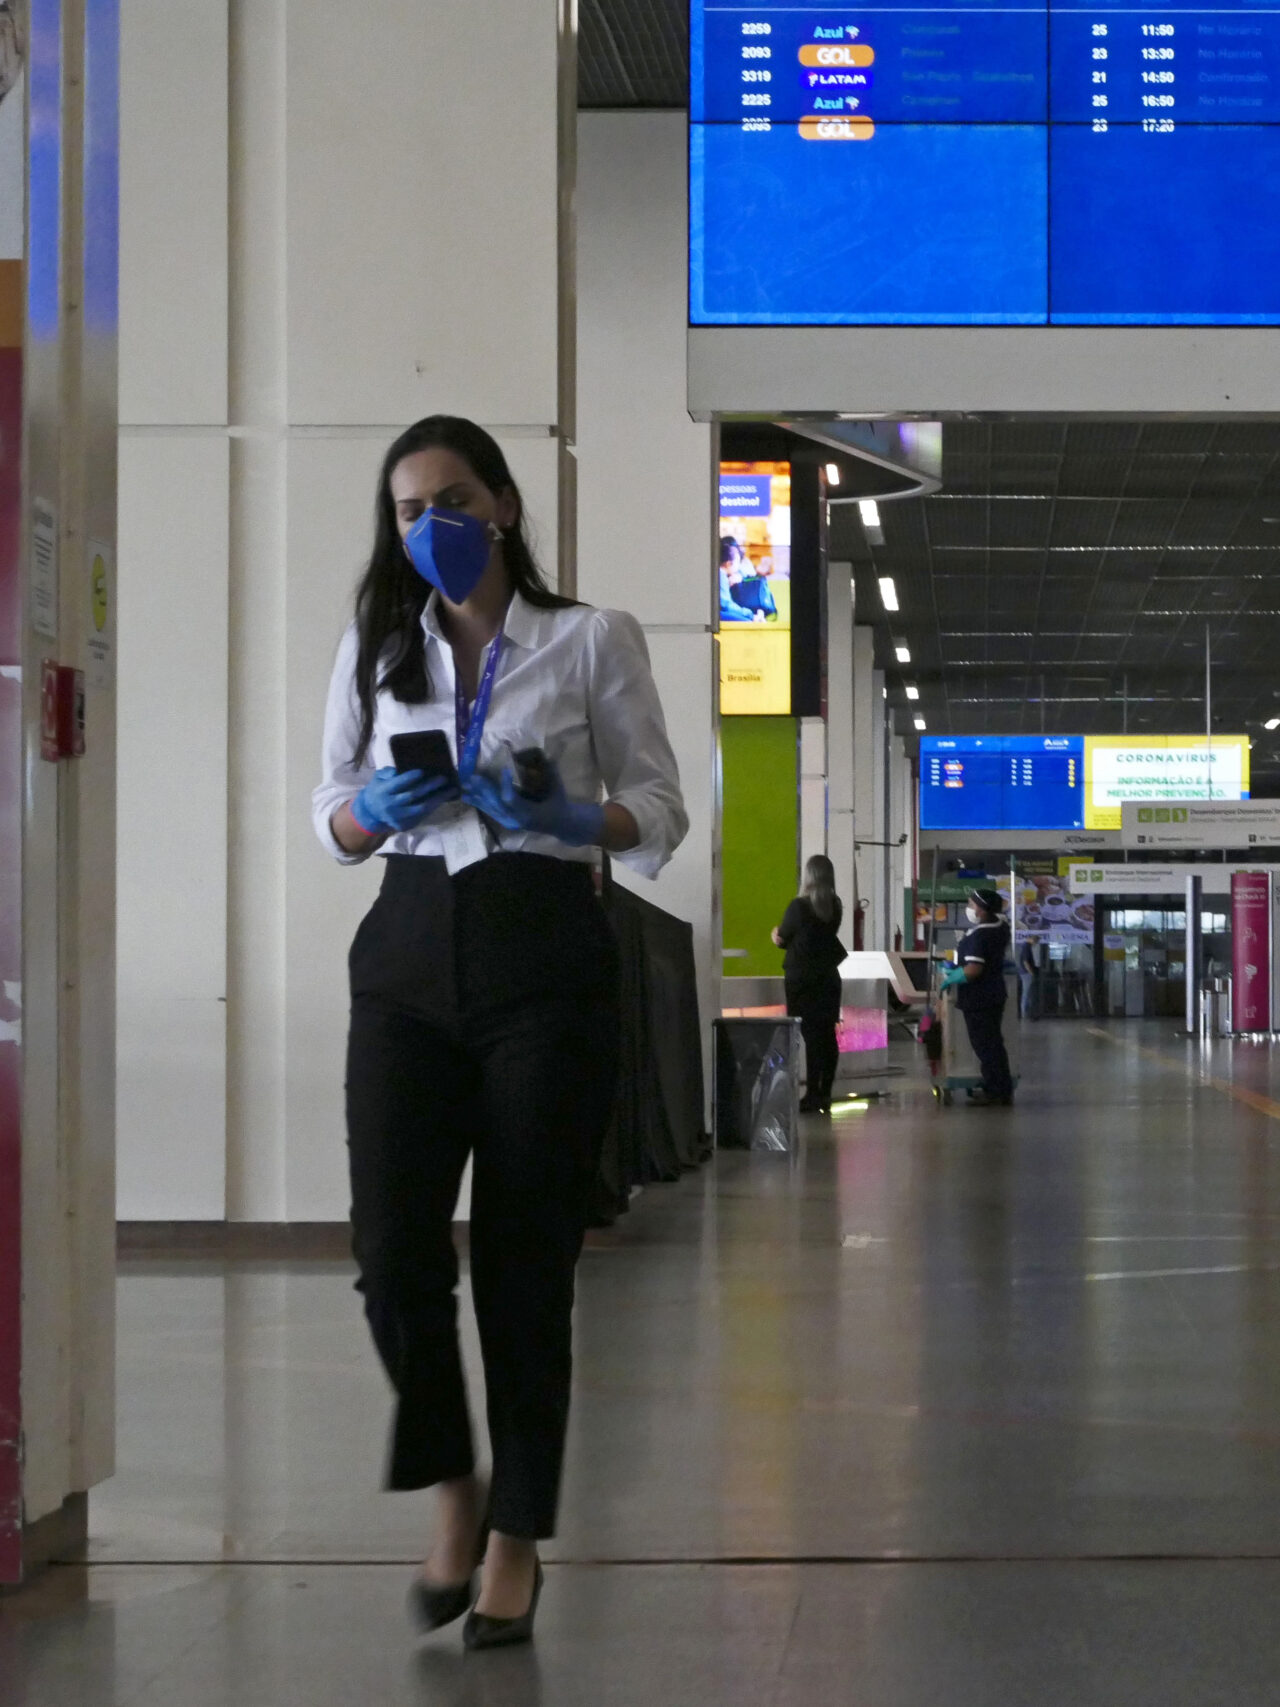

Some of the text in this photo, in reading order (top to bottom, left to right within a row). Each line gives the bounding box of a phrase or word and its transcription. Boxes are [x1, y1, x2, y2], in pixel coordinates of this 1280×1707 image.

[741, 22, 771, 35] 2259
[813, 26, 844, 39] Azul
[1091, 24, 1107, 36] 25
[816, 47, 855, 65] GOL
[1091, 47, 1108, 60] 23
[741, 70, 771, 82] 3319
[819, 75, 866, 84] LATAM
[1091, 71, 1107, 83] 21
[741, 94, 771, 106] 2225
[813, 96, 844, 109] Azul
[1091, 95, 1108, 107] 25
[816, 118, 855, 137] GOL
[1091, 118, 1108, 132] 23
[1117, 754, 1217, 763] CORONAVÍRUS
[1118, 776, 1193, 786] INFORMAÇÃO
[1107, 789, 1152, 797] MELHOR
